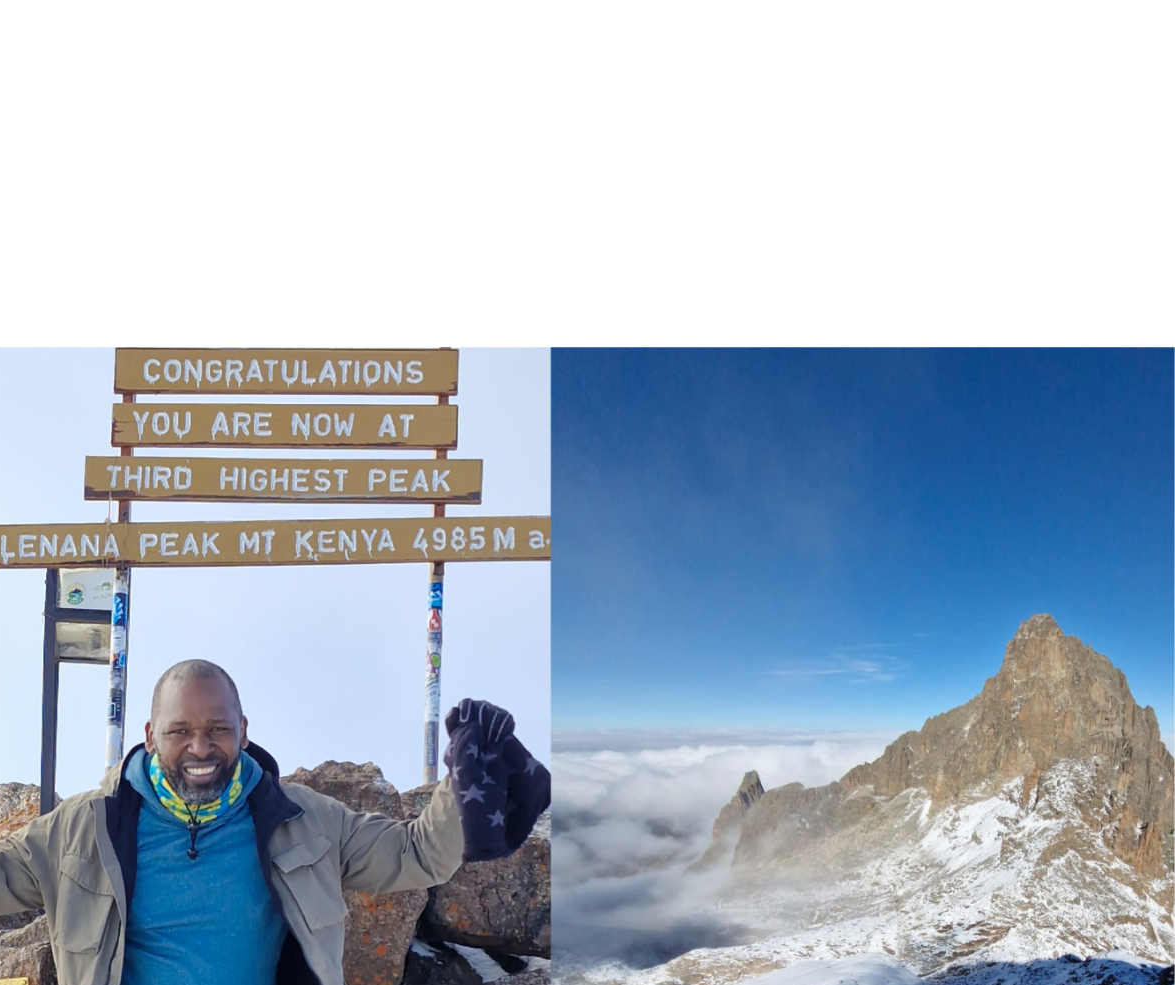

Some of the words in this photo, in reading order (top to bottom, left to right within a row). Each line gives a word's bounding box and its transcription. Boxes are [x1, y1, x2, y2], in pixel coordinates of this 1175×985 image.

[142, 357, 425, 389] CONGRATULATIONS
[133, 411, 192, 439] YOU
[210, 412, 273, 439] ARE
[291, 412, 356, 438] NOW
[378, 413, 415, 439] AT
[106, 464, 193, 491] THIRD
[219, 467, 349, 494] HIGHEST
[367, 469, 451, 494] PEAK
[0, 533, 119, 564] LENANA
[139, 532, 221, 558] PEAK
[239, 529, 276, 556] MT
[294, 528, 396, 561] KENYA
[412, 526, 486, 557] 4985
